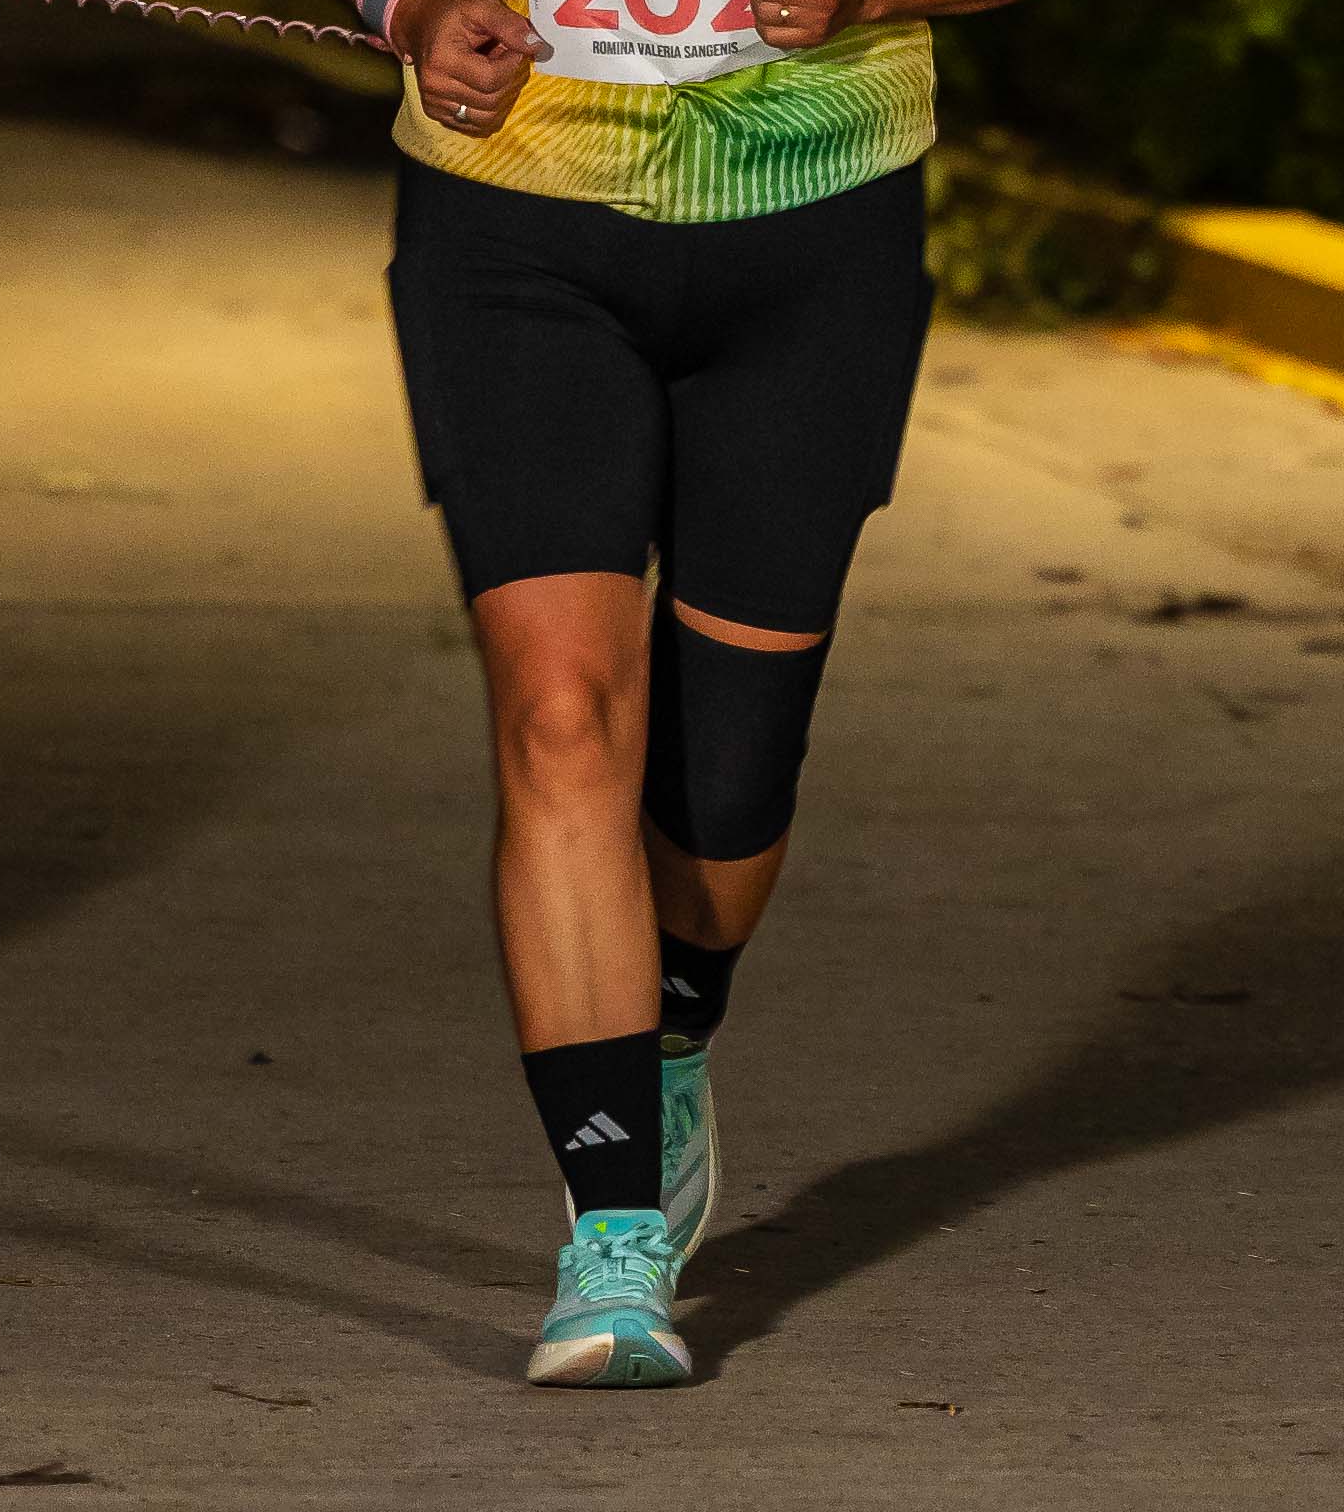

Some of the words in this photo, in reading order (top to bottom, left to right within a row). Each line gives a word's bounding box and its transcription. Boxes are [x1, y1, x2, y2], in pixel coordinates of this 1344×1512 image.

[592, 40, 635, 56] ROMINA
[637, 42, 682, 59] VALERIA
[684, 41, 739, 59] SANGENIS
